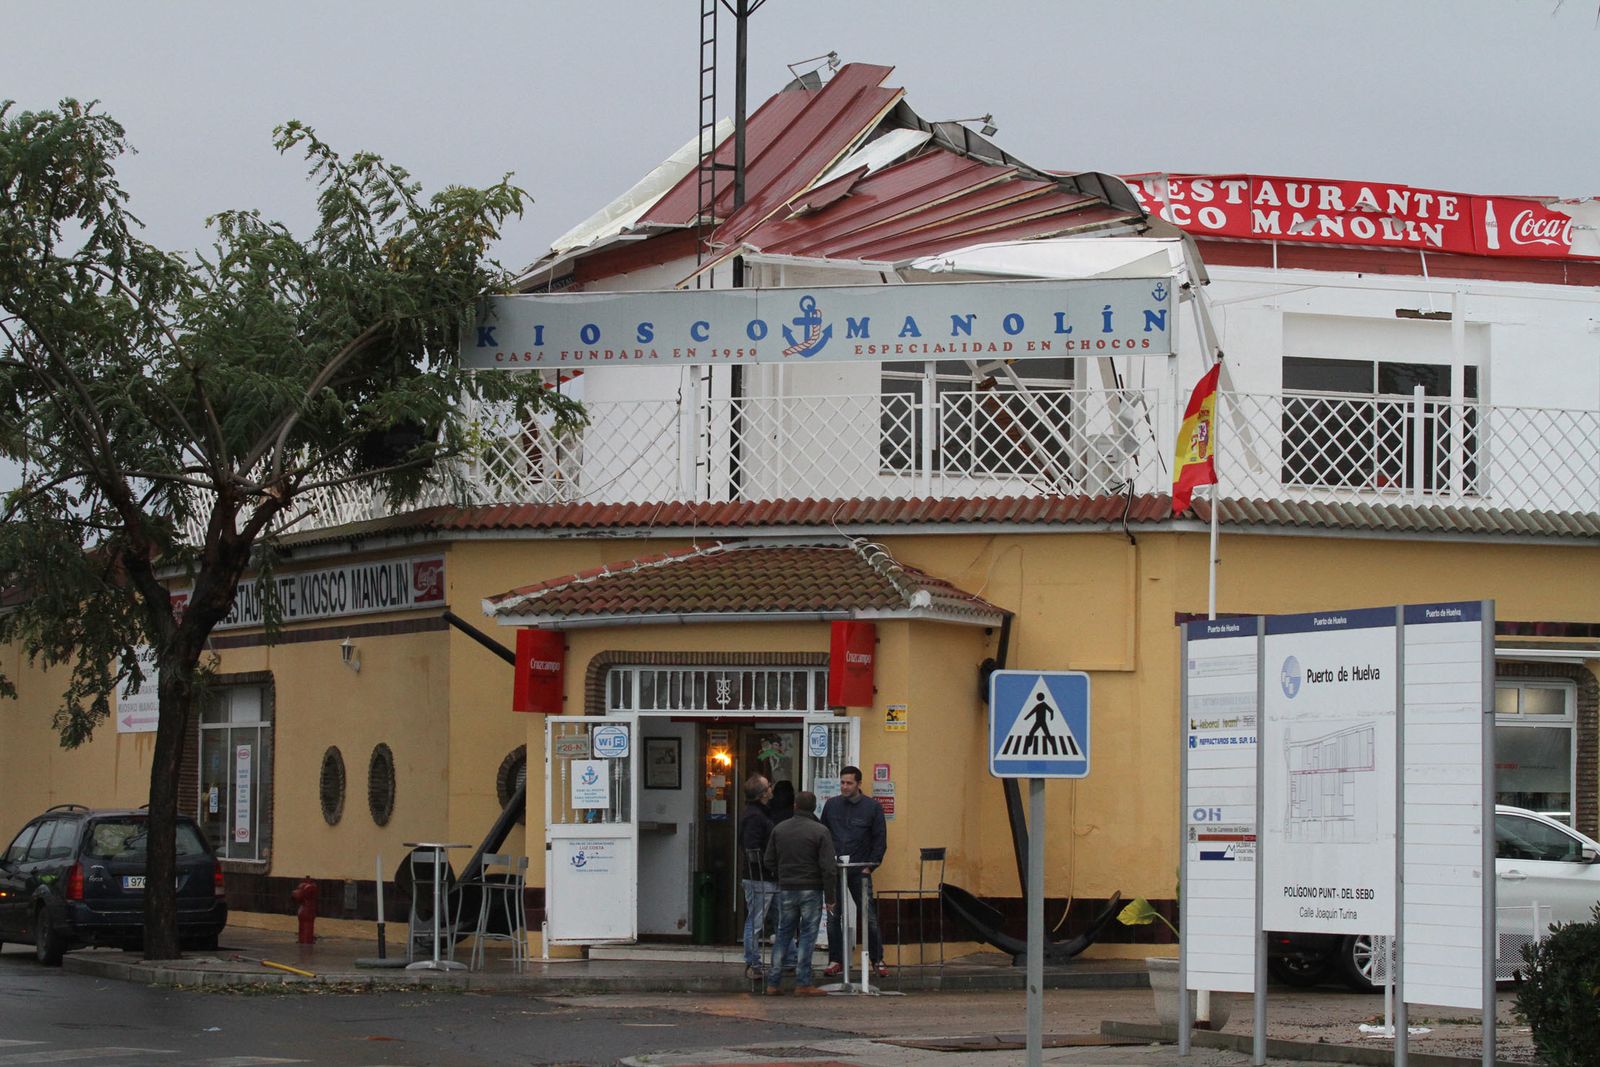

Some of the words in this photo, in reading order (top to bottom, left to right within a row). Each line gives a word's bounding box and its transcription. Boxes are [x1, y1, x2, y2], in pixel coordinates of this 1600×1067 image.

[1252, 209, 1444, 248] MANOLIN
[476, 319, 769, 348] KIOSCO
[845, 305, 1167, 340] MANOLÍN
[495, 351, 545, 363] CASA
[560, 349, 659, 361] FUNDADA
[673, 348, 697, 359] EN
[711, 347, 758, 358] 1950
[854, 341, 1014, 356] ESPECIALIDAD
[1027, 340, 1052, 352] EN
[1065, 338, 1151, 351] CHOCOS
[301, 569, 347, 616] KIOSCO
[351, 562, 409, 610] MANOLIN
[1313, 617, 1327, 626] Puerto
[1327, 616, 1333, 625] de
[1333, 616, 1347, 625] Huelva
[1425, 609, 1439, 618] Puerto
[1440, 608, 1446, 617] de
[1446, 608, 1461, 617] Huelva
[1207, 625, 1220, 633] Puerto
[1226, 624, 1240, 632] Huelva
[531, 658, 560, 672] Cruzcampo
[846, 650, 871, 665] Cruzcampo
[1307, 668, 1334, 683] Puerto
[1337, 665, 1349, 682] de
[1352, 664, 1380, 681] Huelva
[1283, 884, 1318, 899] POLÍGONO
[1341, 888, 1354, 900] DEL
[1355, 888, 1375, 901] SEBO
[1299, 906, 1314, 918] Calle
[1339, 907, 1358, 920] Turina
